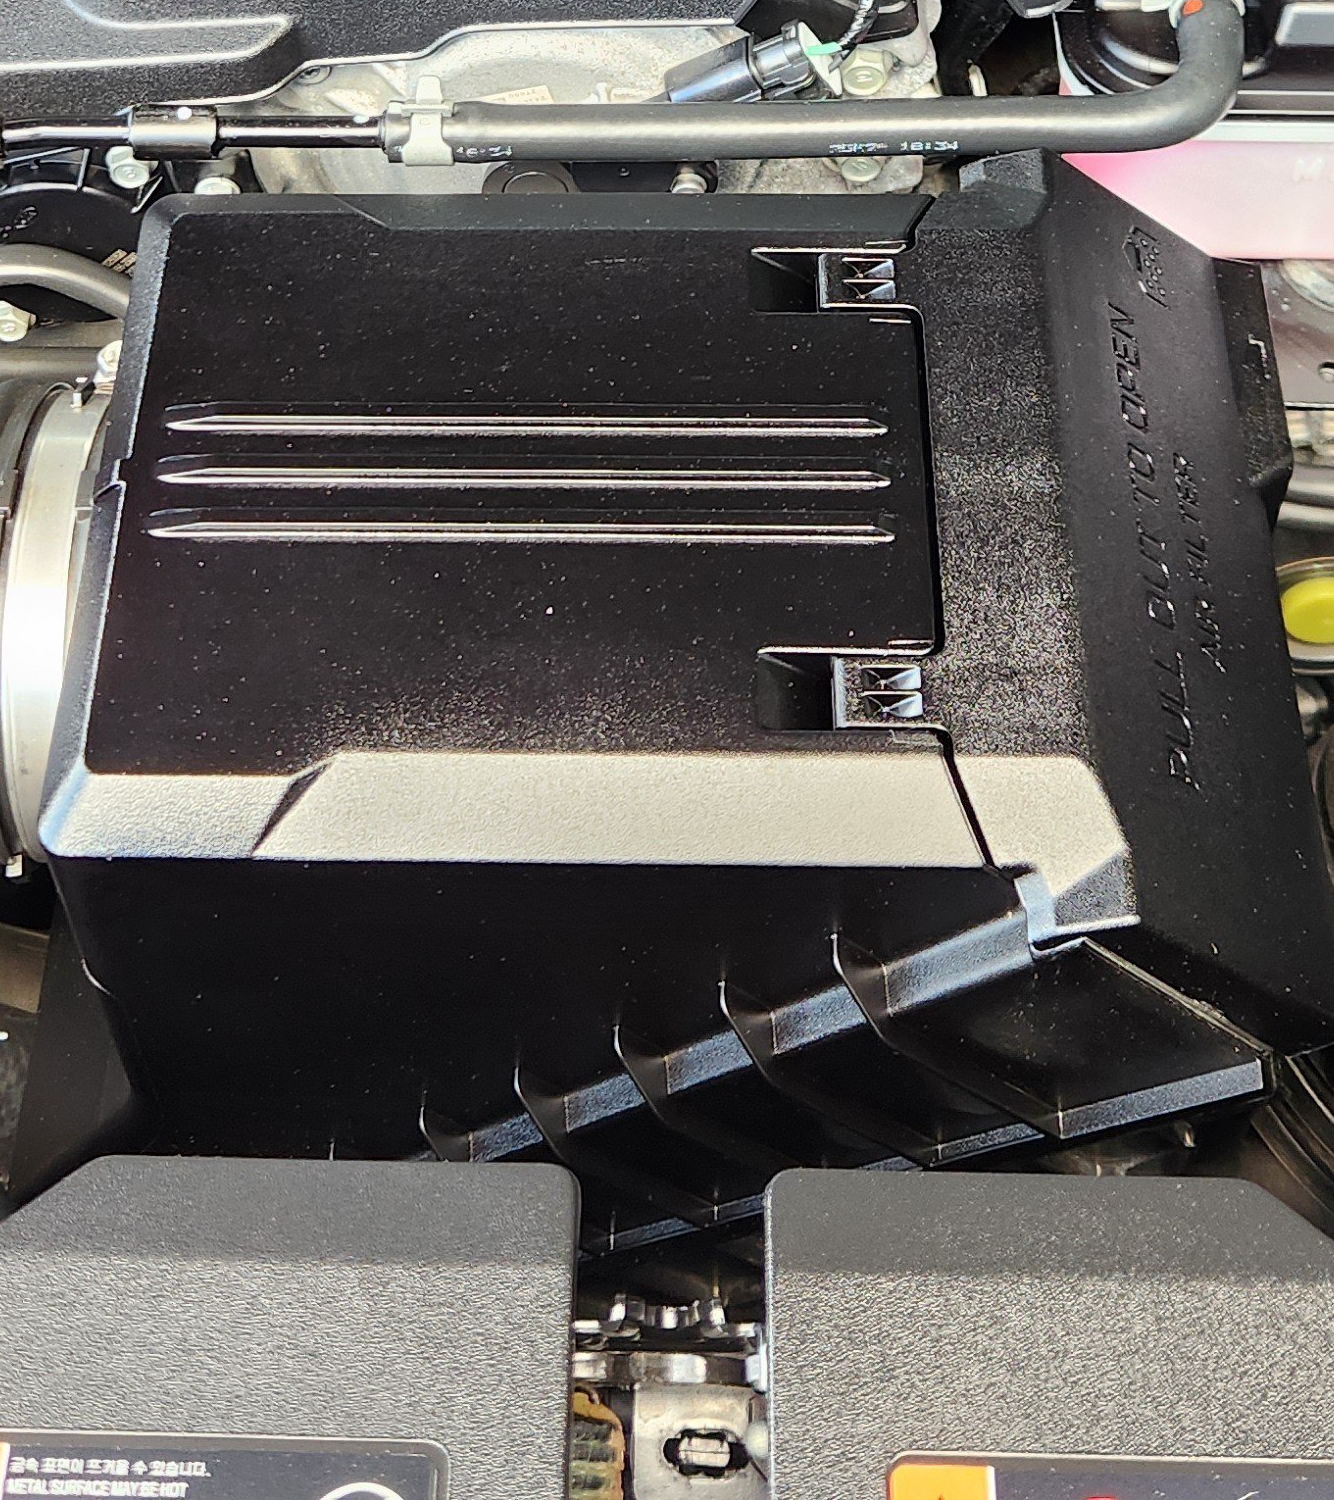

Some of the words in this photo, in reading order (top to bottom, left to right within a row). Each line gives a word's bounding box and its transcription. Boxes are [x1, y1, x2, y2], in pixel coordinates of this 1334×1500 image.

[1110, 303, 1150, 433] OPEN
[1126, 442, 1160, 507] TO
[1135, 518, 1176, 631] OUT
[1153, 648, 1201, 792] PULL
[5, 1477, 49, 1495] METAL
[48, 1478, 111, 1497] SURFACE
[110, 1480, 139, 1498] MAY
[138, 1481, 161, 1498] BE
[159, 1481, 190, 1499] HOT
[9, 1456, 40, 1474] 금속
[40, 1457, 86, 1475] 표면이
[130, 1460, 149, 1476] 수
